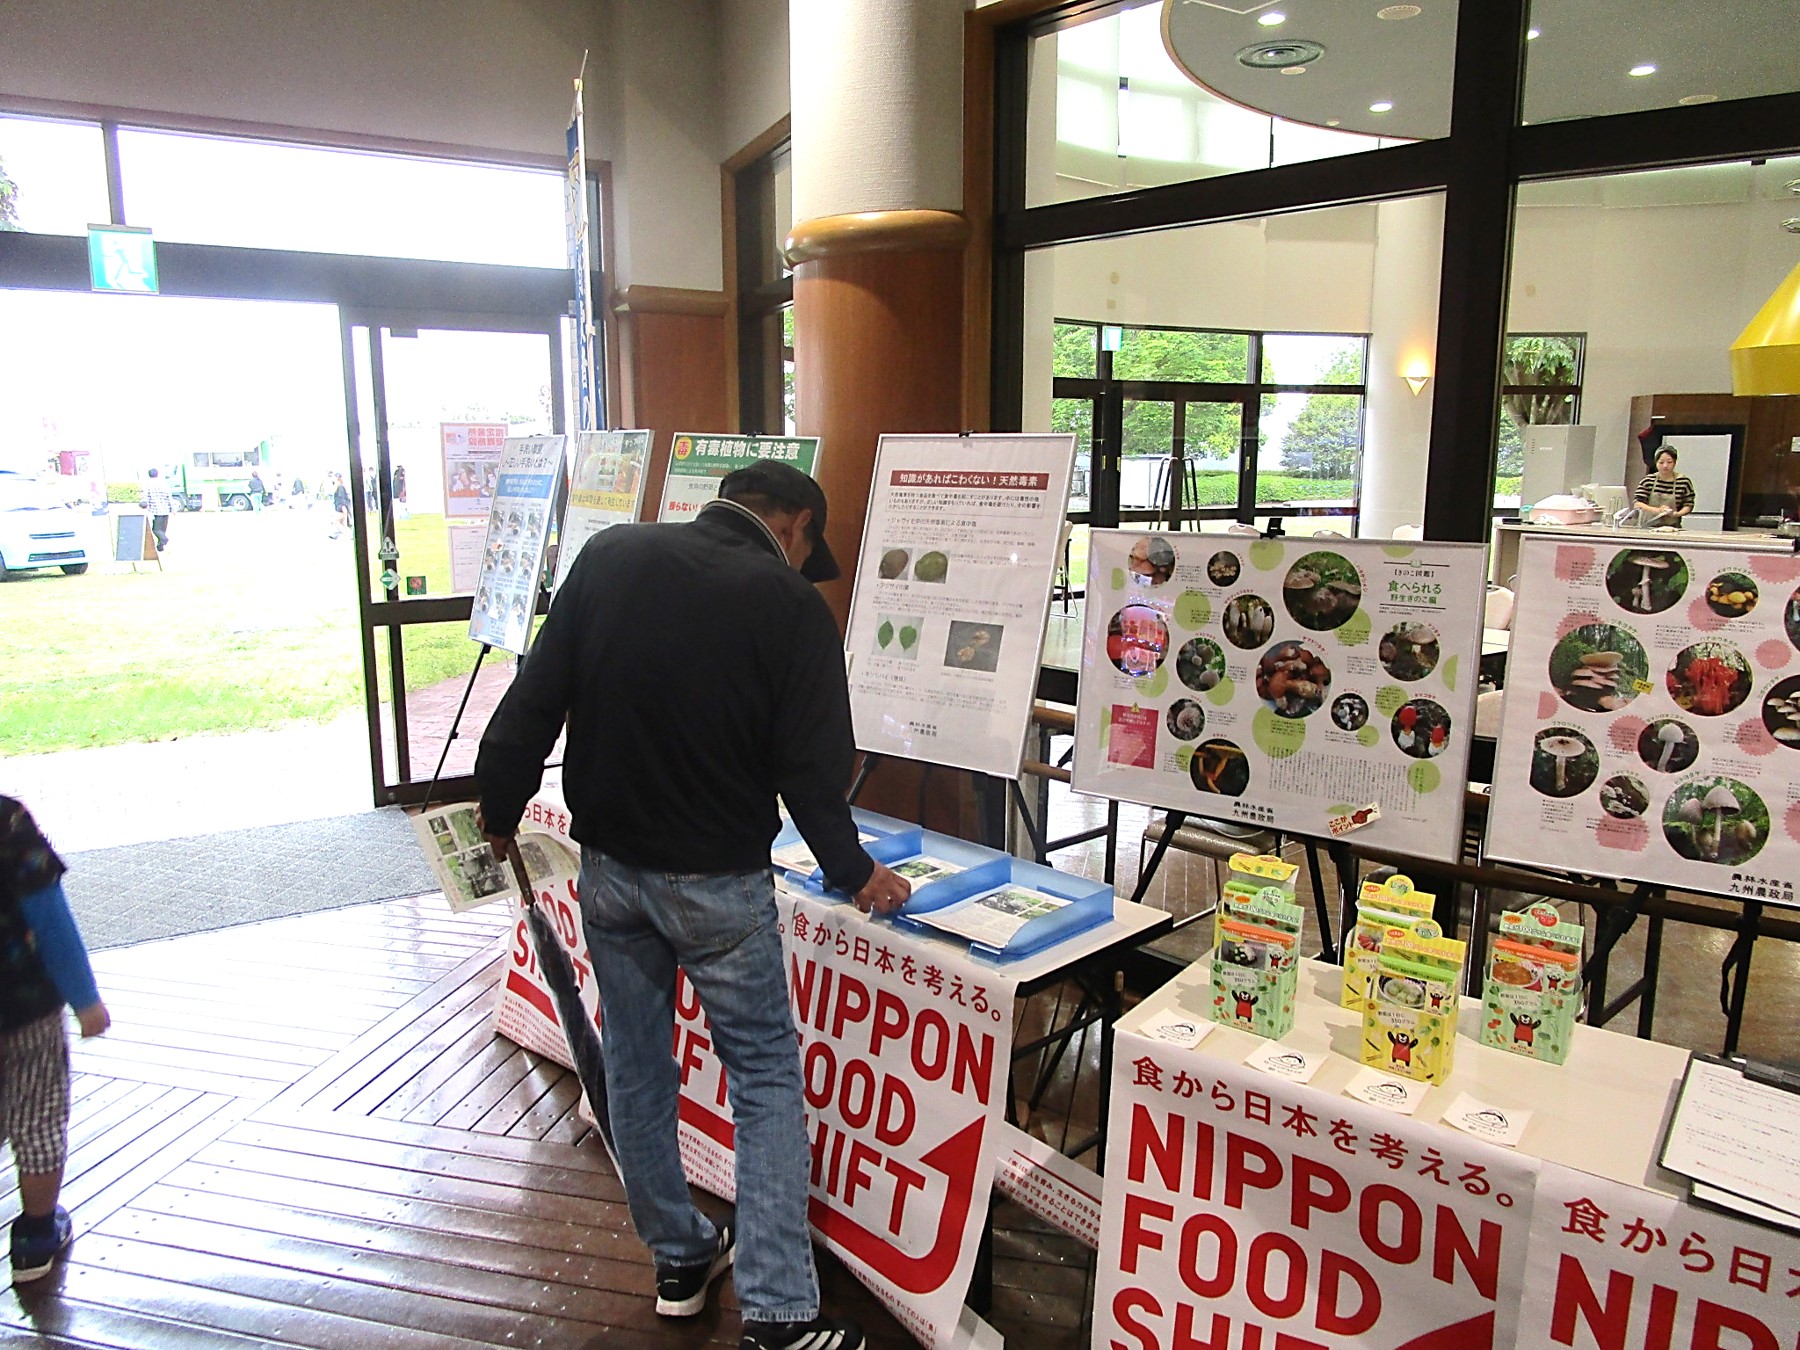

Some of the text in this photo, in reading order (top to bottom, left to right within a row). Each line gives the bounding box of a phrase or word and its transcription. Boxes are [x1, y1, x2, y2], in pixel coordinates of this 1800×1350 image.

[695, 439, 800, 460] 有毒植物に要注意
[1388, 580, 1442, 594] 食べられる
[1391, 594, 1437, 604] 野生きのこ編
[1233, 800, 1274, 814] 農林水産省
[1329, 815, 1348, 829] ここが
[1732, 873, 1793, 890] 農林水産省
[1729, 883, 1794, 902] 九州農政局
[793, 912, 1002, 1023] 食から日本を考える。
[789, 951, 995, 1106] NIPPON
[799, 1033, 916, 1147] OOD
[1132, 1055, 1513, 1208] 食から日本を考える。
[1127, 1102, 1502, 1302] NIPPON
[1120, 1193, 1381, 1336] FOOD
